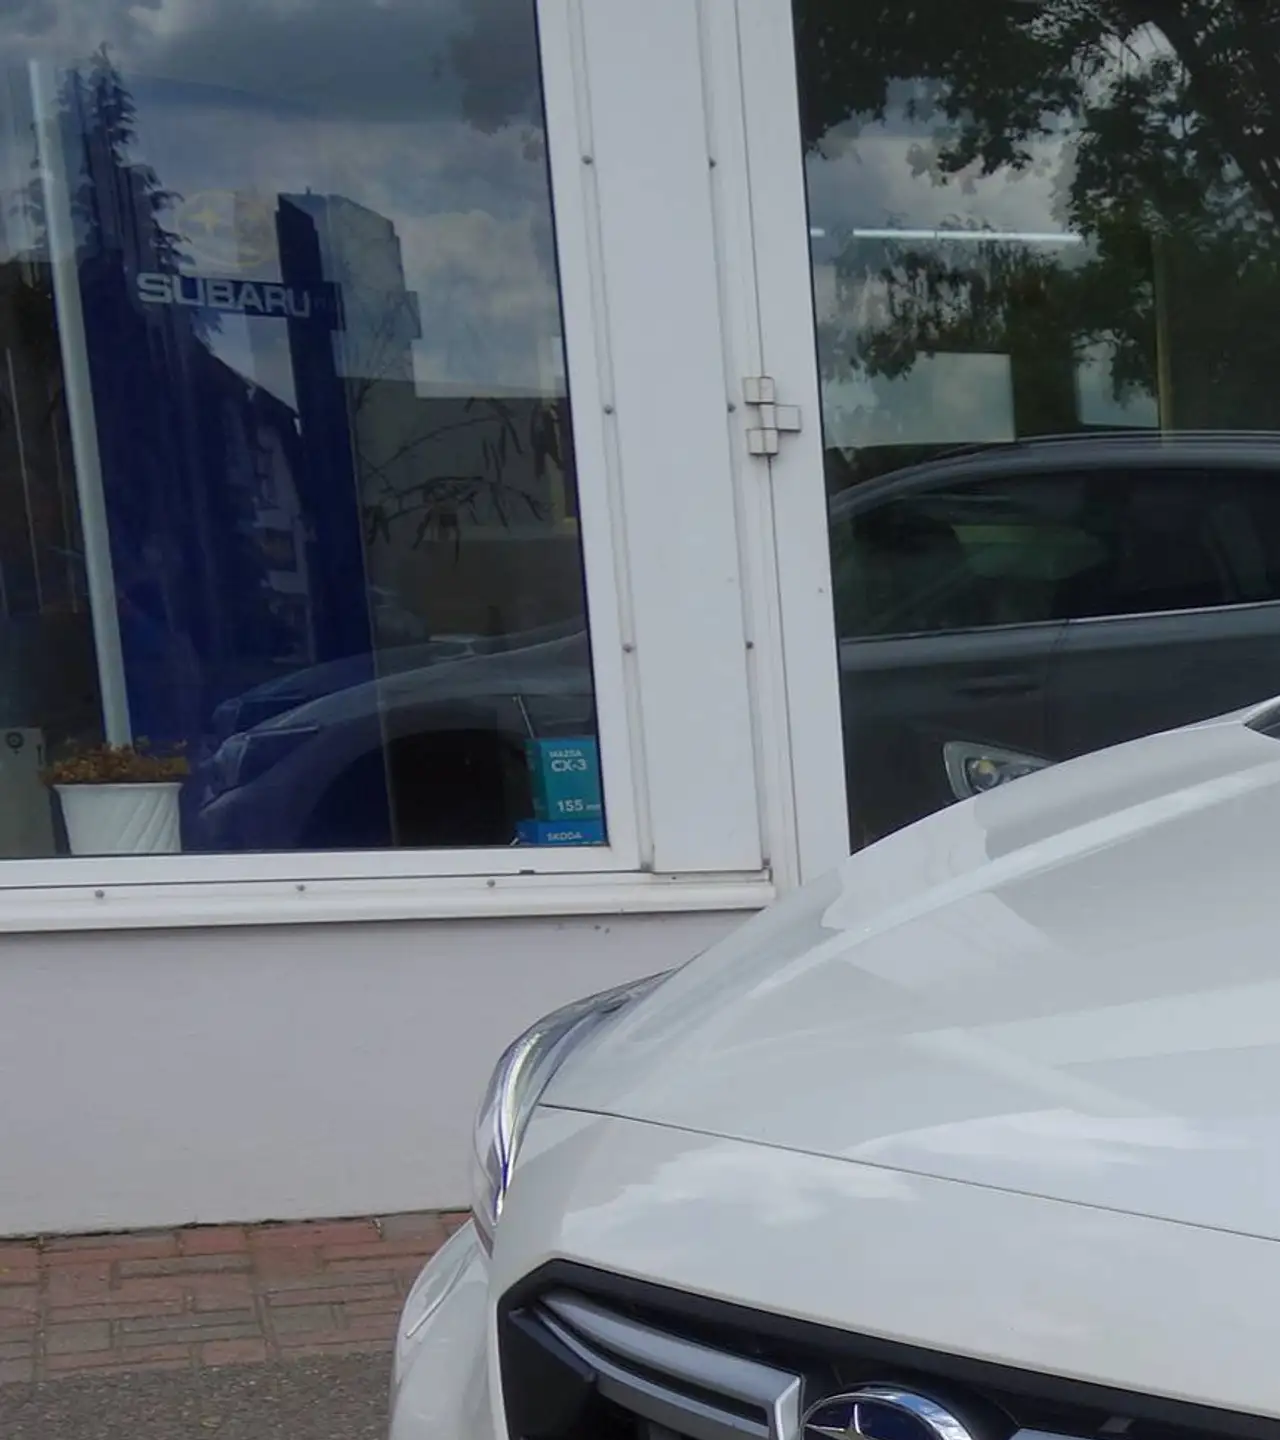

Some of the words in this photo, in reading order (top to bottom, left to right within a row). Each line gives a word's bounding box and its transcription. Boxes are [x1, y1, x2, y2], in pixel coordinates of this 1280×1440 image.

[136, 272, 311, 318] SUBARU
[551, 759, 588, 773] CX-3
[557, 799, 584, 813] 155
